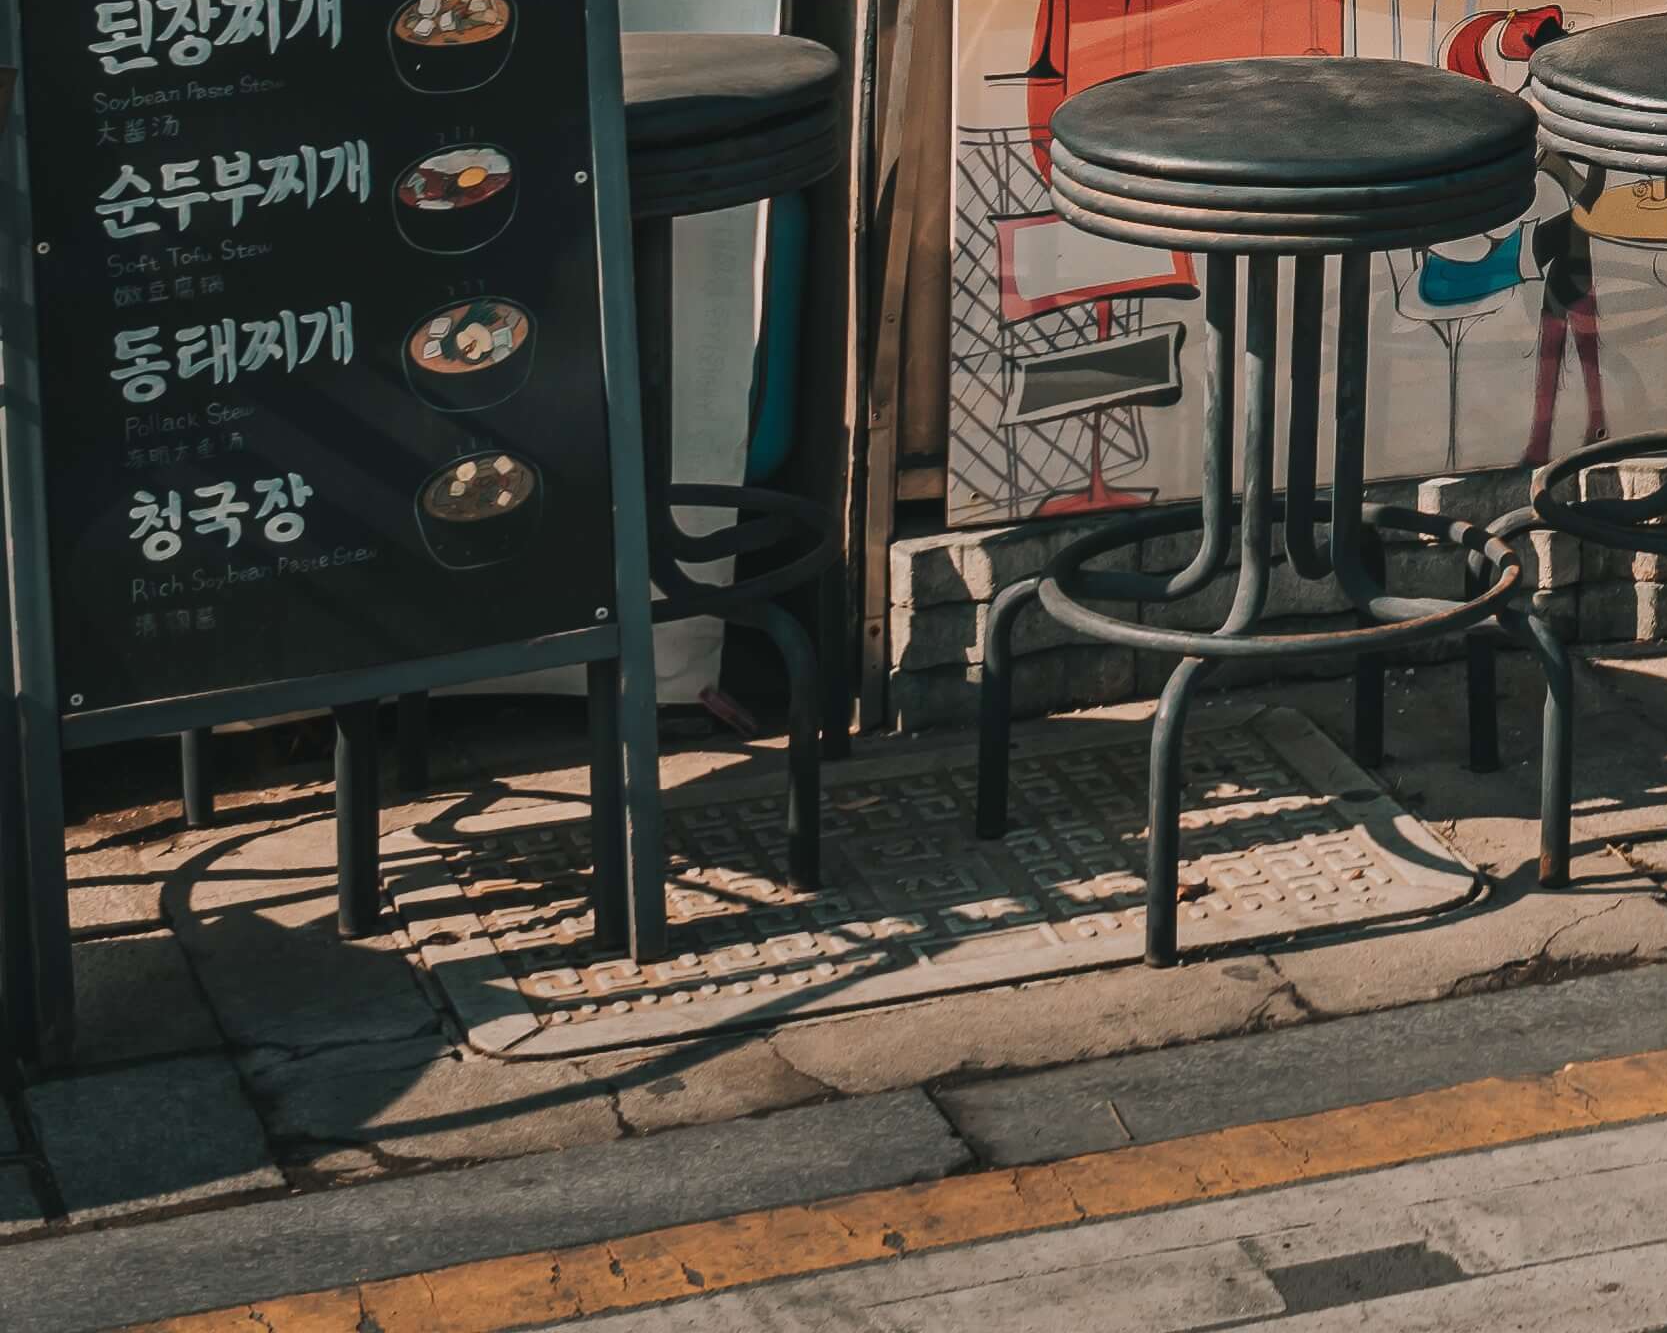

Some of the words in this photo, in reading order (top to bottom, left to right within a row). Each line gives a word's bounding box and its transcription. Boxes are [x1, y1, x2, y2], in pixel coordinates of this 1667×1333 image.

[93, 87, 181, 114] Soybean
[95, 139, 370, 239] 순두부찌개
[107, 253, 161, 278] Soft
[166, 246, 214, 268] Tofu
[220, 239, 274, 261] Stew
[110, 301, 353, 403] 동태찌개
[125, 412, 200, 441] Pollack
[207, 402, 256, 425] Stew
[129, 472, 313, 562] 청국장
[131, 574, 185, 605] Rich
[277, 555, 330, 577] Paste
